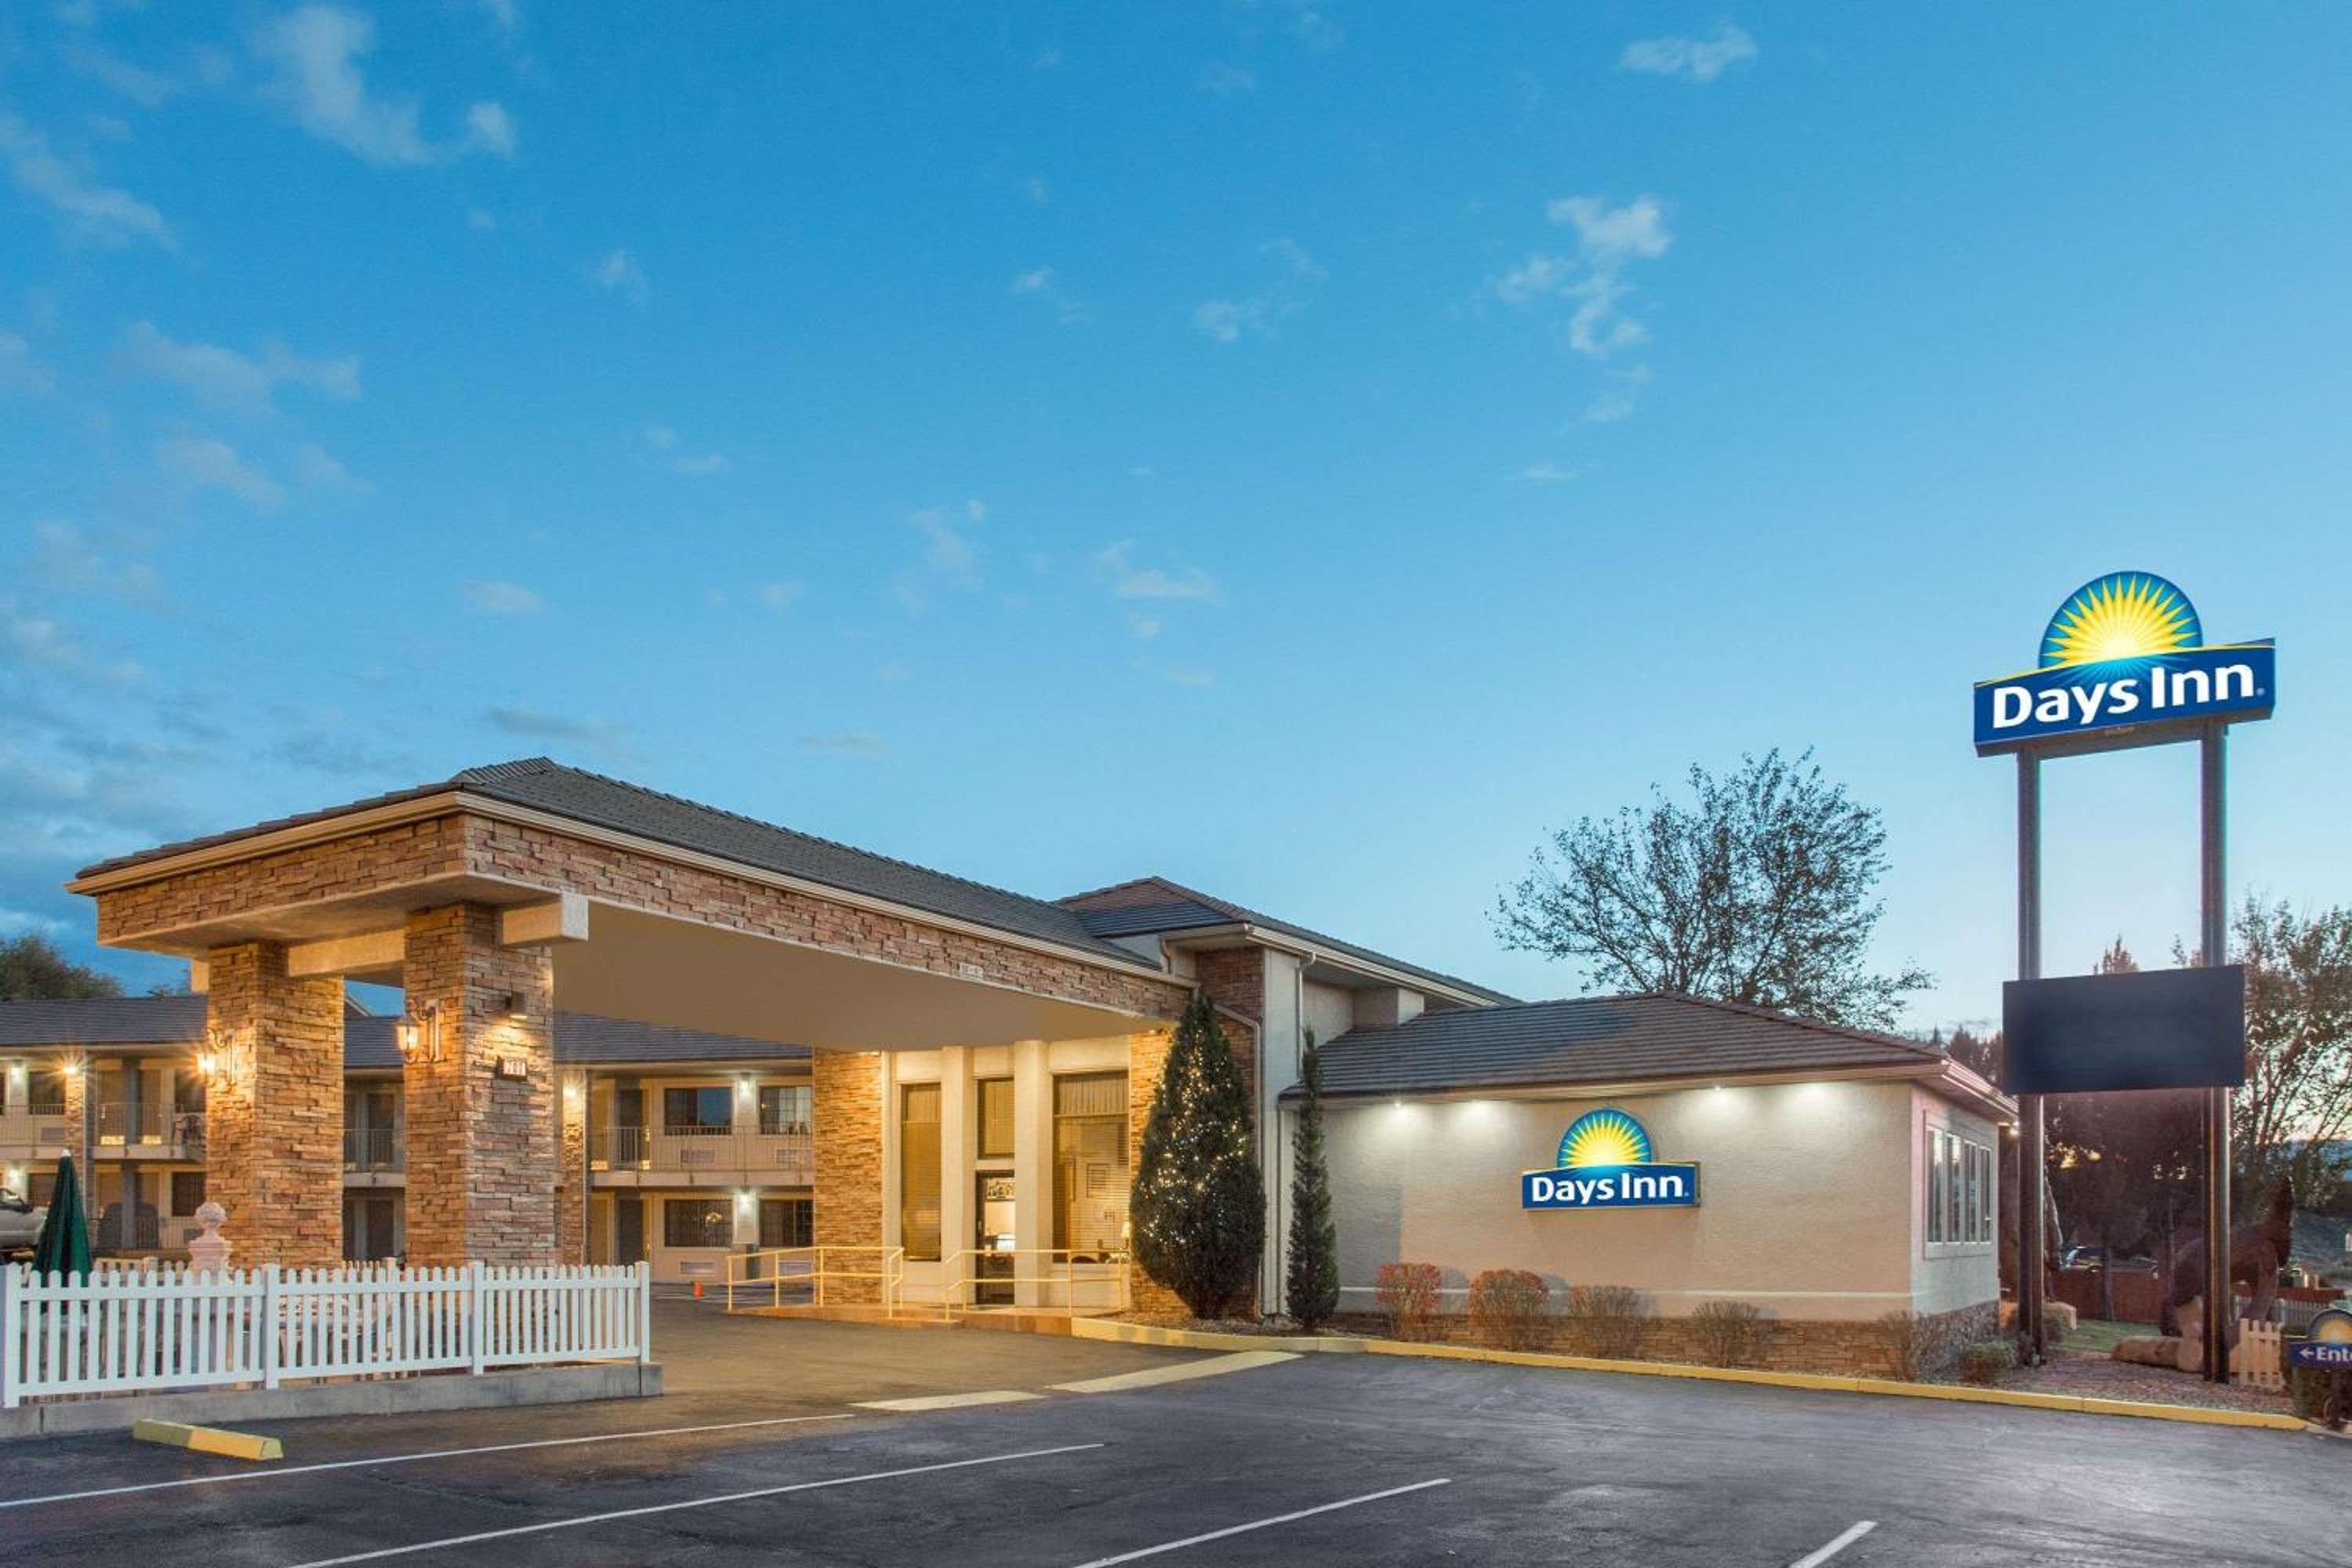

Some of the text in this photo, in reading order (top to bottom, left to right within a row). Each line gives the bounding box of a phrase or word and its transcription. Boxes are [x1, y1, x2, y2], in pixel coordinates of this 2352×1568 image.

[1992, 663, 2255, 729] Days Inn
[1531, 1173, 1683, 1204] Days Inn
